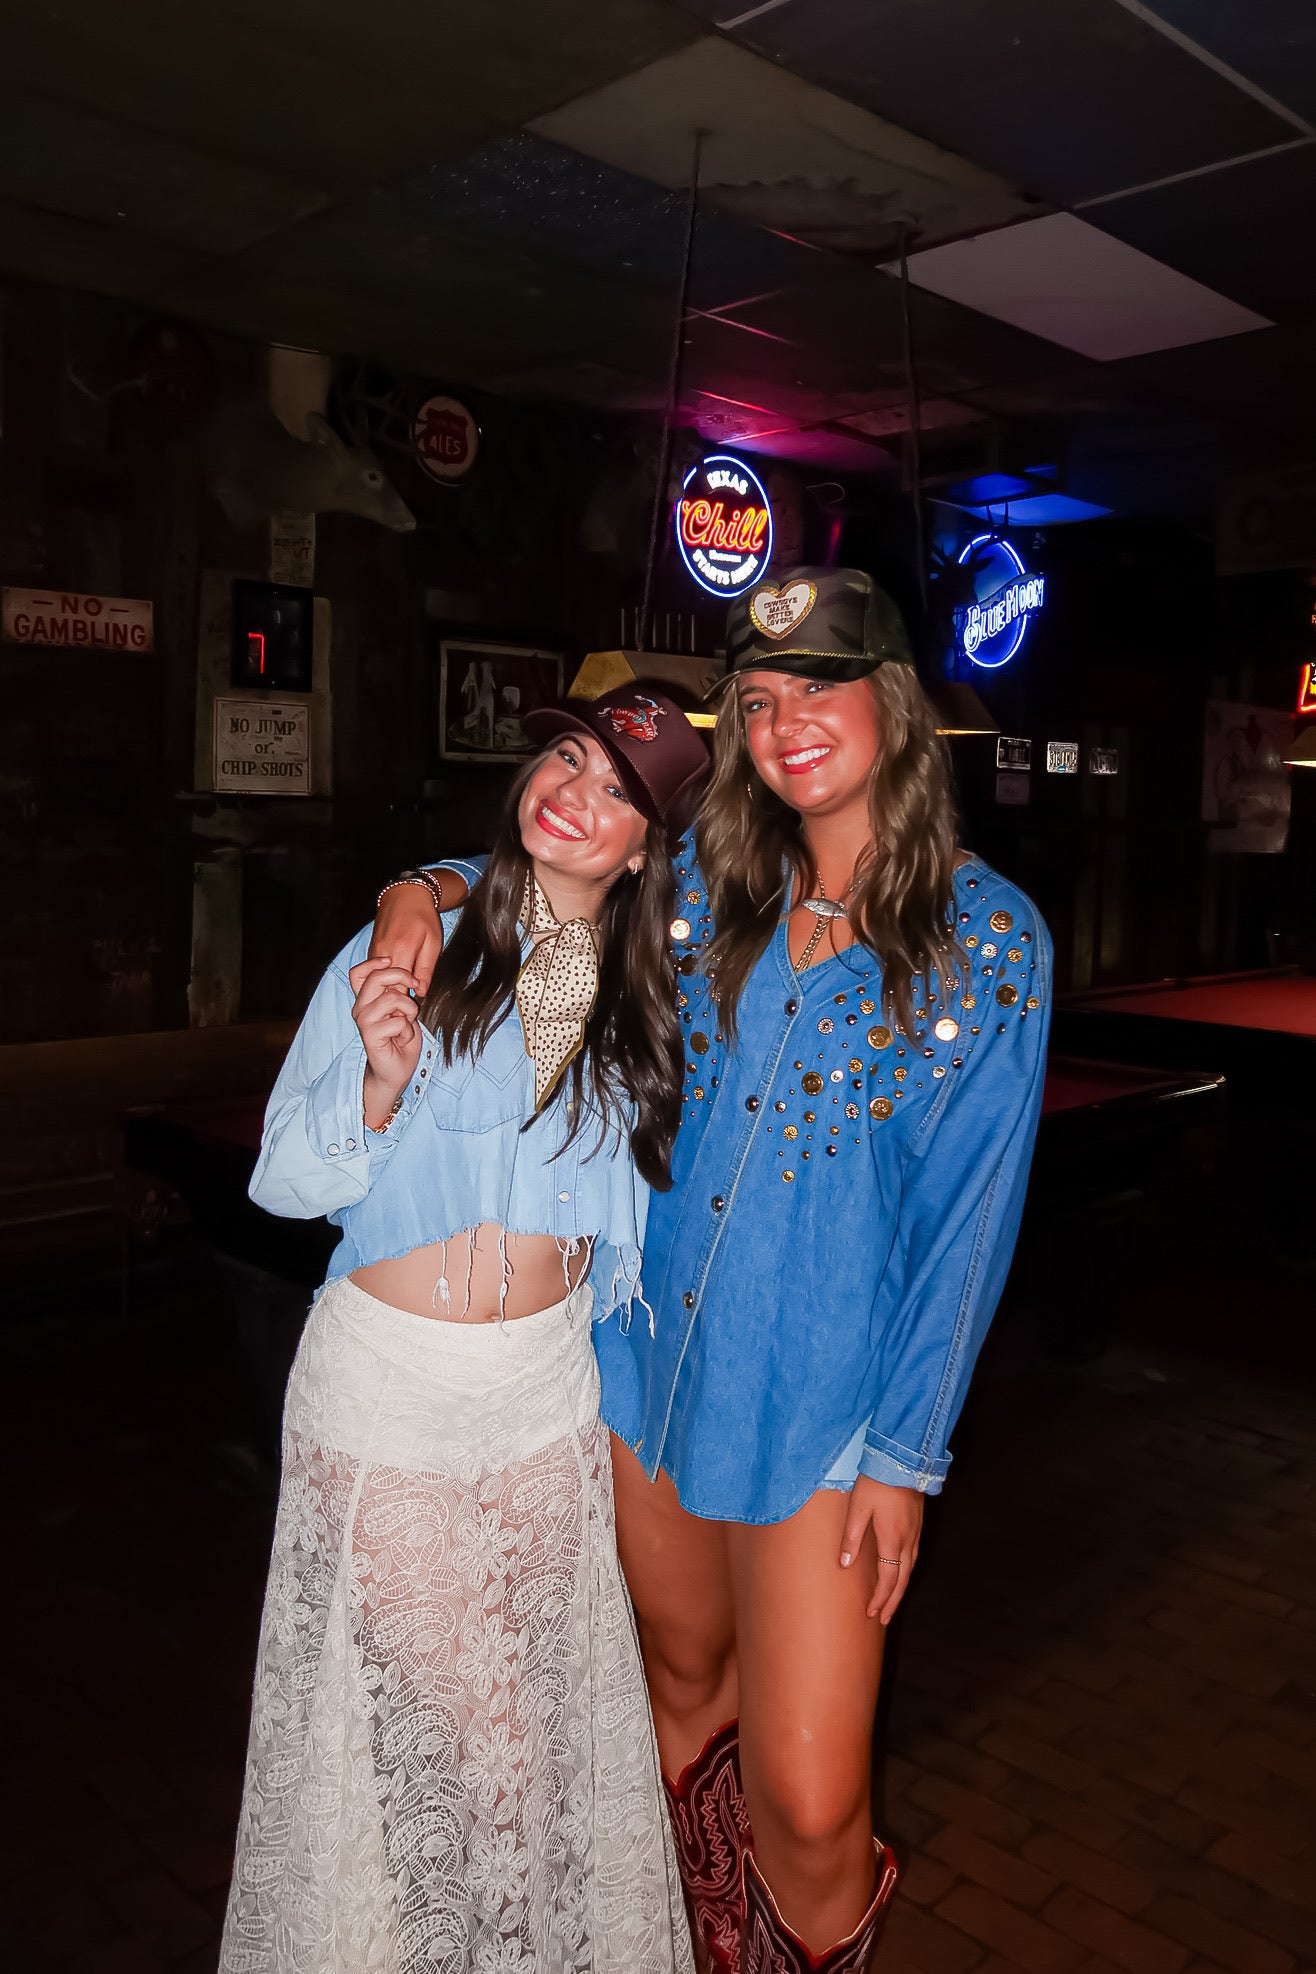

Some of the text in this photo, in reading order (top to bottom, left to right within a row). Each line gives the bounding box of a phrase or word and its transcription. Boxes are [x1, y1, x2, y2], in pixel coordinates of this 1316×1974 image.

[706, 470, 749, 495] TEXAS
[682, 500, 769, 552] Chill
[61, 594, 103, 617] NO
[766, 610, 794, 621] BETTER
[769, 604, 791, 614] MAKE
[14, 613, 146, 647] GAMBLING
[229, 716, 297, 736] NO JUMP
[221, 759, 304, 777] CHIP SHOTS
